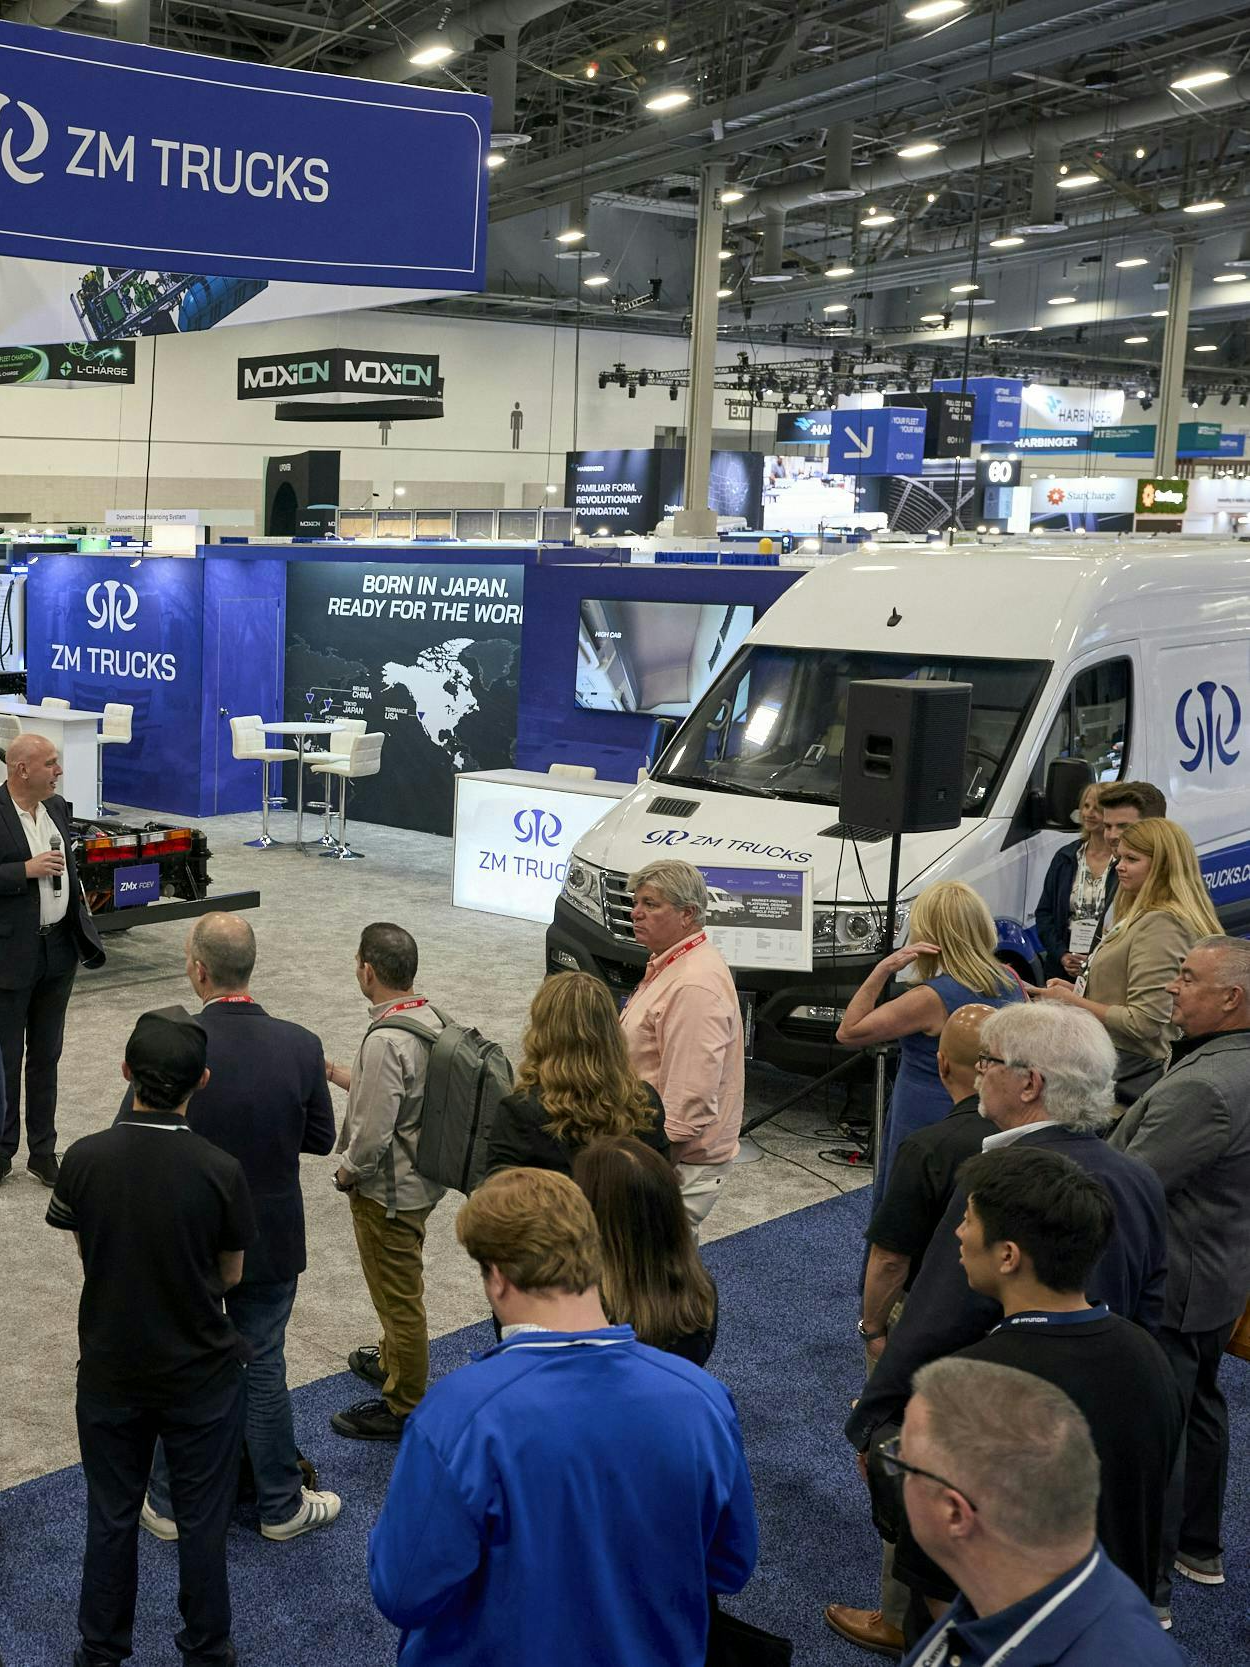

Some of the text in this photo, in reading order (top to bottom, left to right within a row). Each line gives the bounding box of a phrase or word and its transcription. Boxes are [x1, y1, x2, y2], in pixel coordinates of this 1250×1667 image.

[65, 126, 330, 203] ZM TRUCKS
[0, 355, 11, 363] FLEET
[11, 353, 34, 361] CHARGING
[77, 365, 128, 376] L-CHARGE
[730, 406, 750, 418] EXIT
[1059, 408, 1112, 424] HARBINGER
[1014, 437, 1078, 448] HARBINGER
[576, 483, 637, 493] FAMILIAR FORM.
[575, 495, 643, 504] REVOLUTIONARY
[1067, 491, 1116, 501] StarCharge
[575, 506, 630, 516] FOUNDATION.
[116, 513, 133, 521] Dynamic
[362, 575, 509, 598] BORN IN JAPAN.
[328, 598, 387, 617] READY
[389, 599, 426, 620] FOR
[431, 602, 469, 622] THE
[609, 631, 622, 639] CAB
[51, 644, 177, 682] ZM TRUCKS
[352, 692, 372, 700] CHINA
[343, 707, 364, 715] JAPAN
[384, 706, 408, 714] TORRANCE
[688, 834, 813, 864] ZM TRUCKS
[479, 850, 507, 871] ZM
[120, 880, 155, 892] ZMx FCEV
